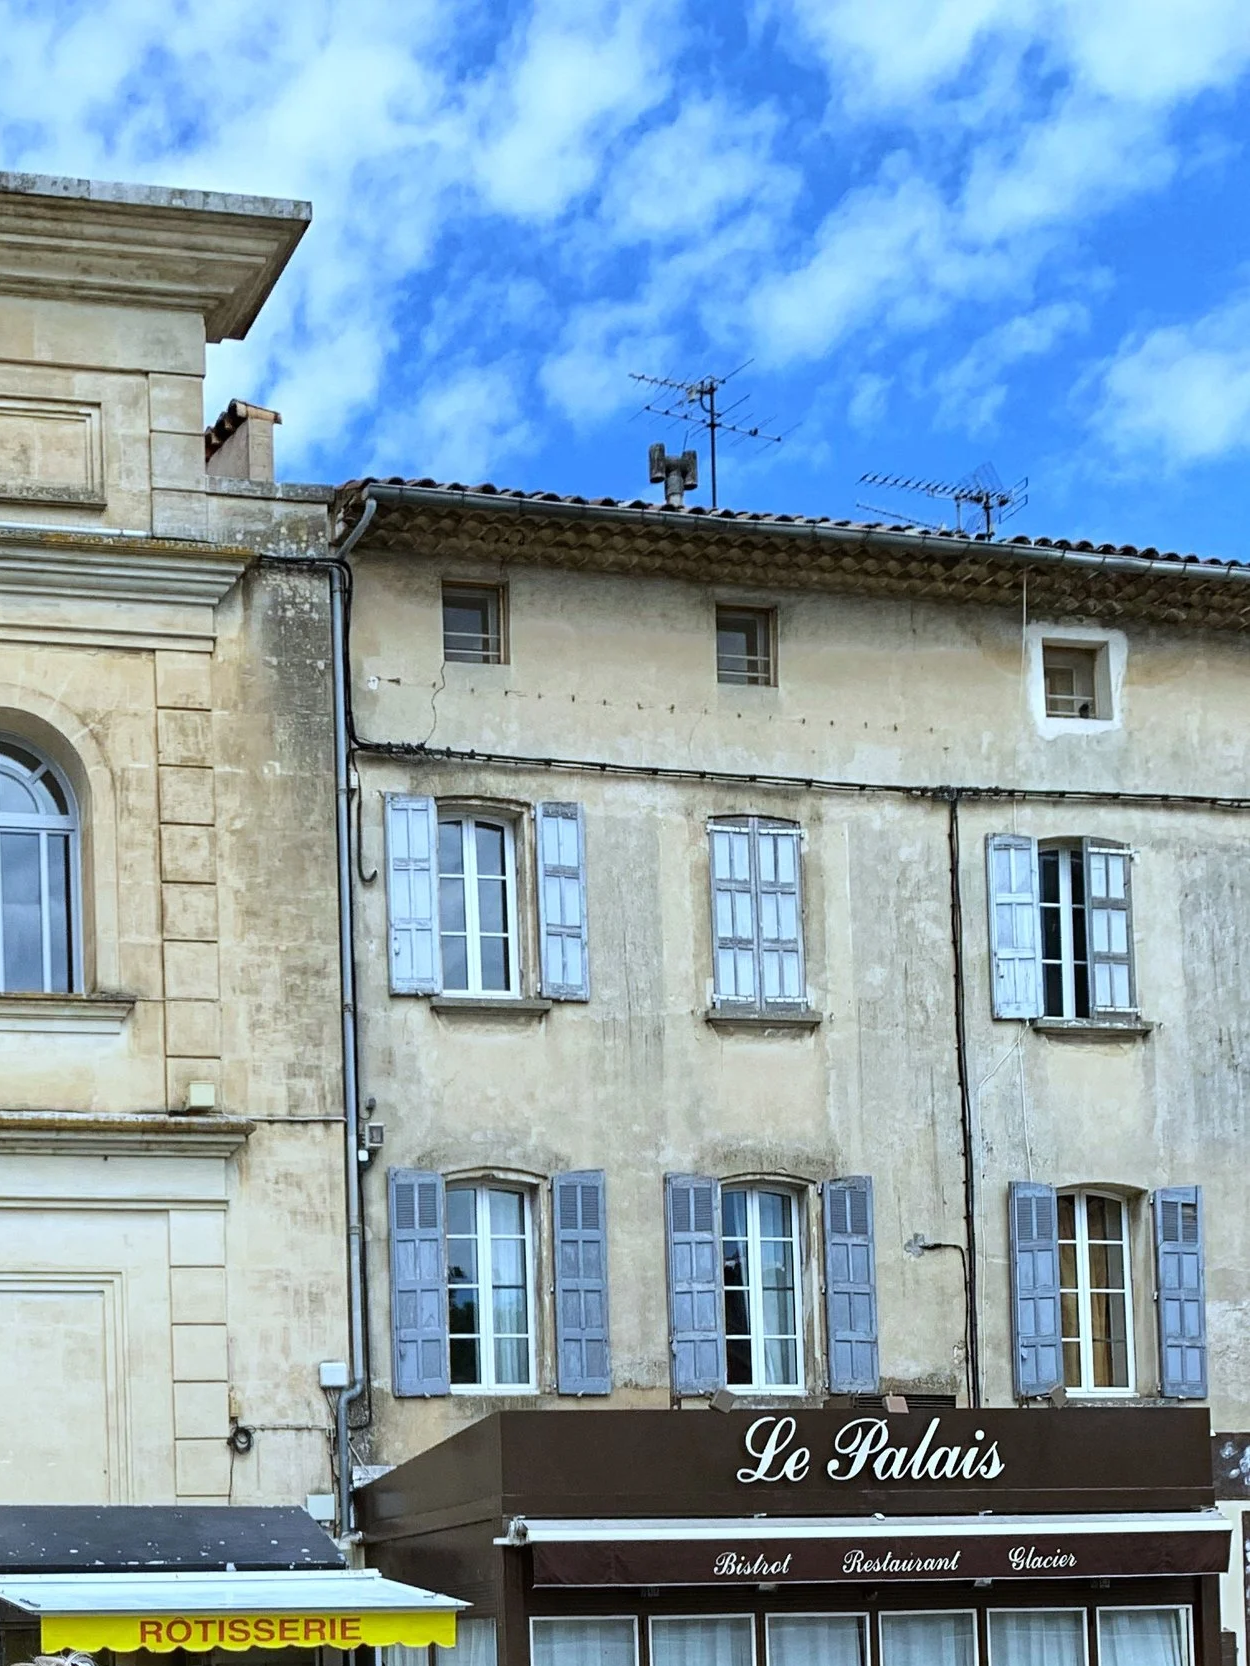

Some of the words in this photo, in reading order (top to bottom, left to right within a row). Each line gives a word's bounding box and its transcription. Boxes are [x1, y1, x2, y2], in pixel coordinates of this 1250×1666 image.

[736, 1416, 811, 1484] Le
[826, 1416, 1005, 1482] Palais
[713, 1550, 794, 1577] Bistrot
[841, 1547, 962, 1574] Restaurant
[1008, 1545, 1078, 1572] Glacier
[139, 1616, 363, 1645] RÔTISSERIE
